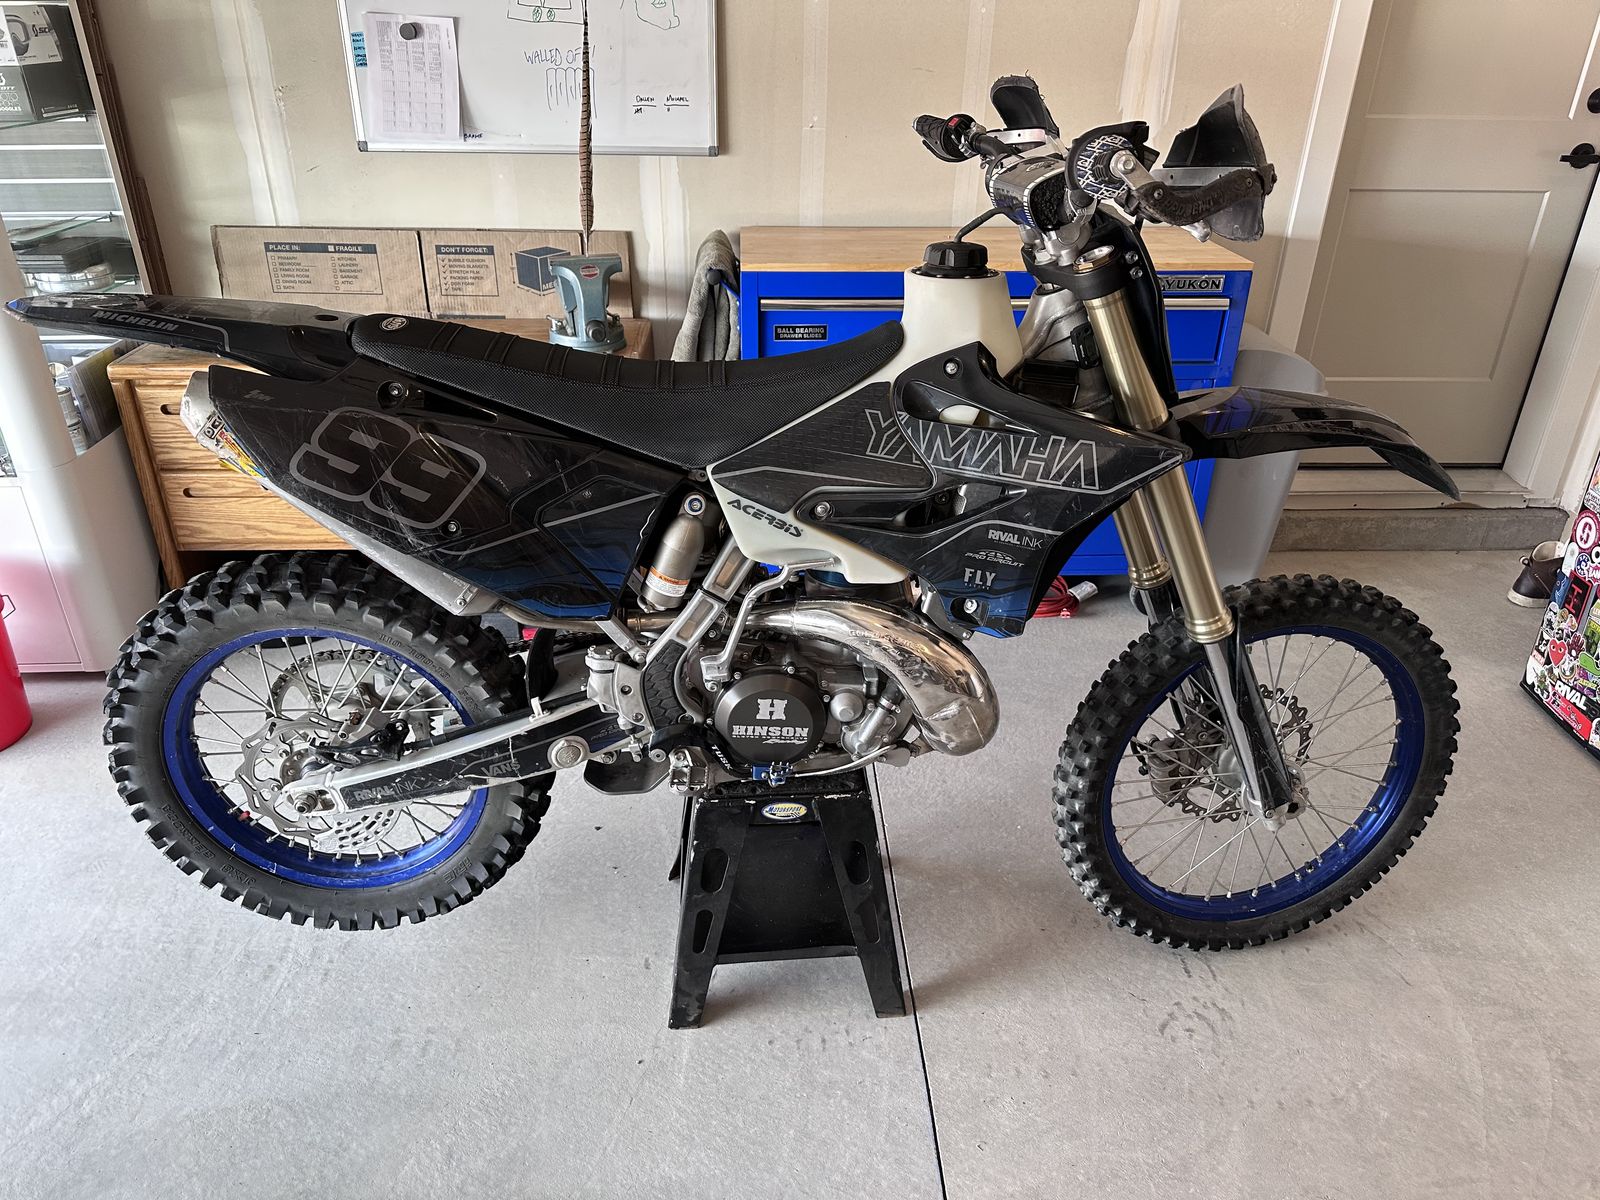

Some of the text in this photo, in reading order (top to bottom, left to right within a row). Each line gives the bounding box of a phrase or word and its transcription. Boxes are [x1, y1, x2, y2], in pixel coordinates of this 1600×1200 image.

[523, 47, 562, 66] WALLED
[1165, 279, 1221, 290] YUKON
[93, 310, 180, 332] MICHELIN
[864, 408, 1100, 491] YAMAHA
[988, 529, 1020, 544] RIVAL
[1021, 536, 1044, 549] INK
[964, 551, 1025, 567] PRO CIRCUIT
[963, 567, 996, 587] FLY
[1554, 681, 1587, 711] RIVAL
[732, 725, 809, 737] HINSON
[711, 744, 733, 770] TUSK
[481, 759, 521, 778] VANS
[354, 779, 422, 802] RIVAL INK
